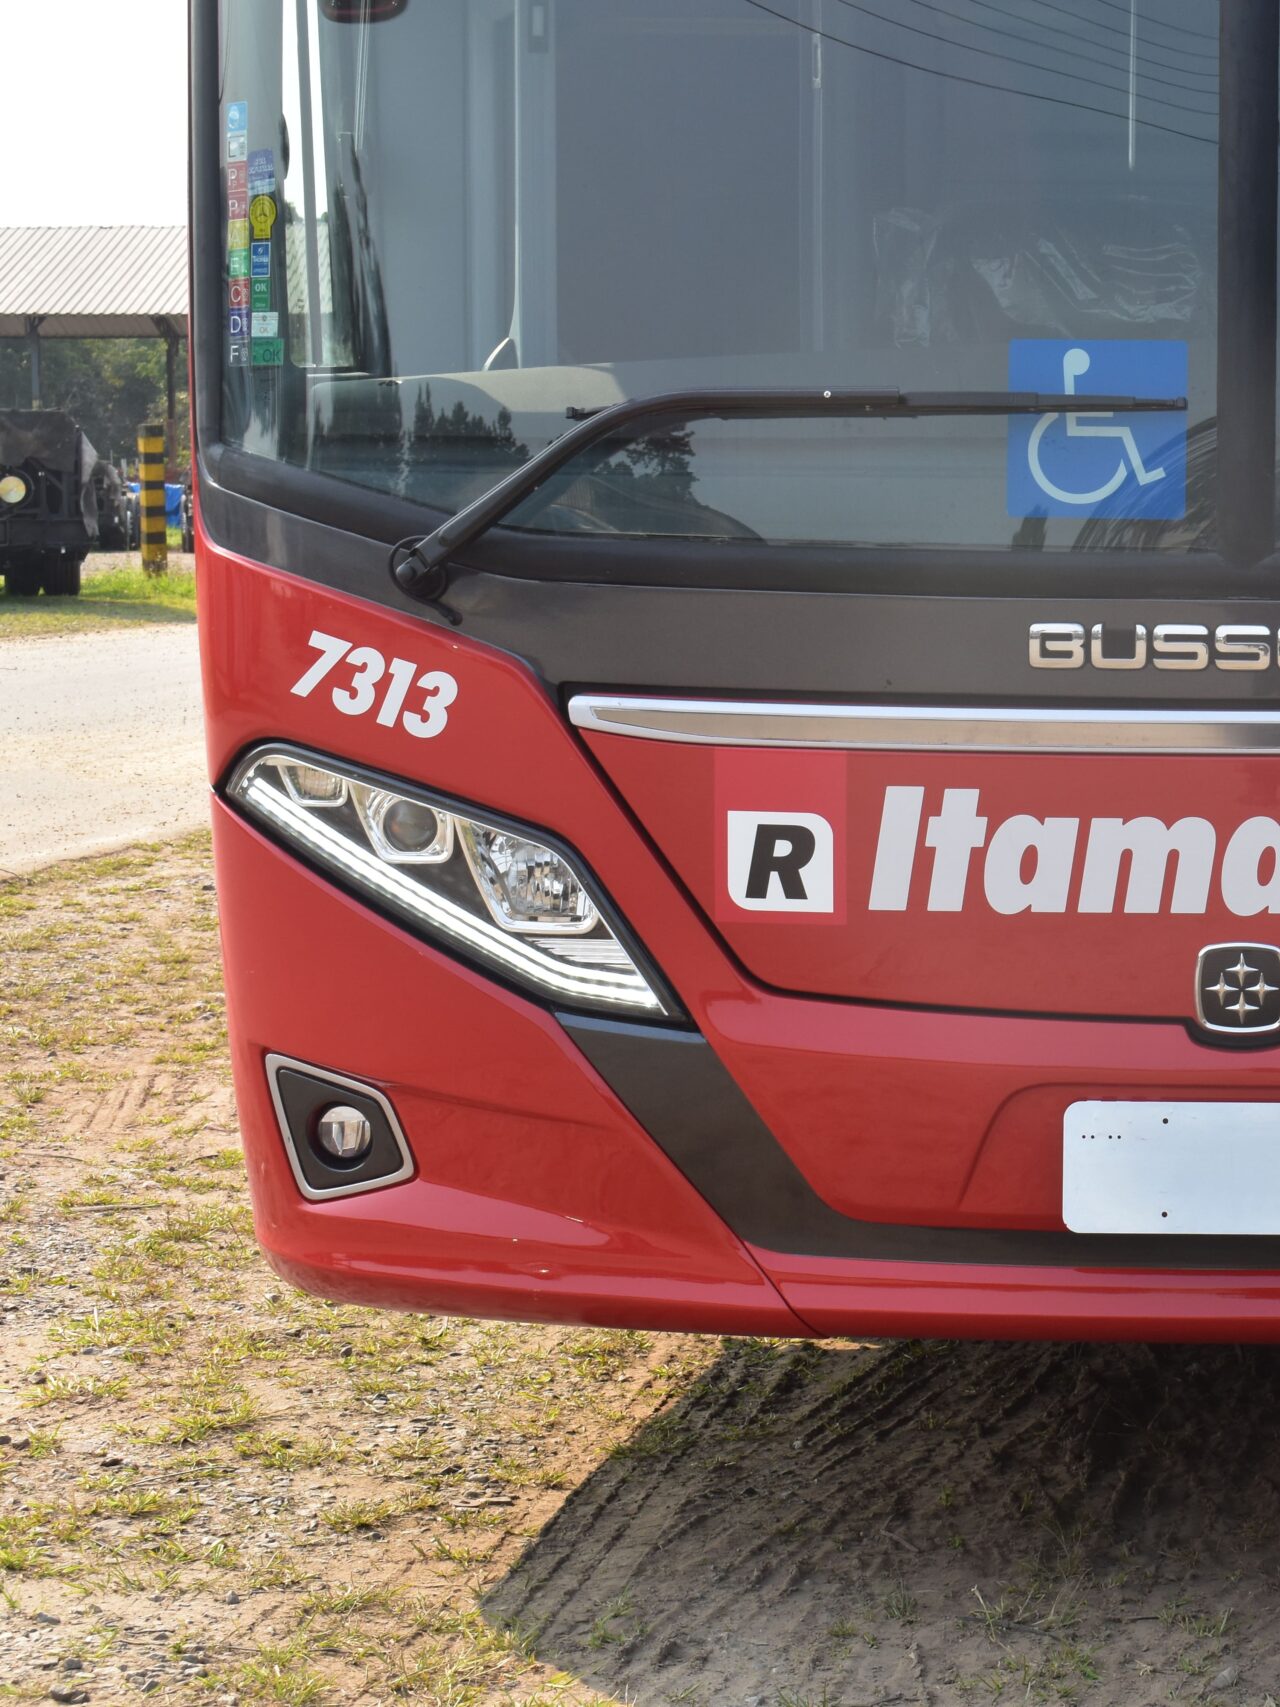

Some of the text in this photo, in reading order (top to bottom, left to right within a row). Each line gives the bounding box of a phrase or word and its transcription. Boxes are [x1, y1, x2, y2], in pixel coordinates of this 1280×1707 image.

[230, 285, 241, 303] C
[254, 283, 267, 292] OK
[230, 315, 241, 333] D
[230, 345, 239, 363] F
[262, 349, 281, 362] OK
[290, 630, 458, 738] 7313
[745, 823, 816, 900] R
